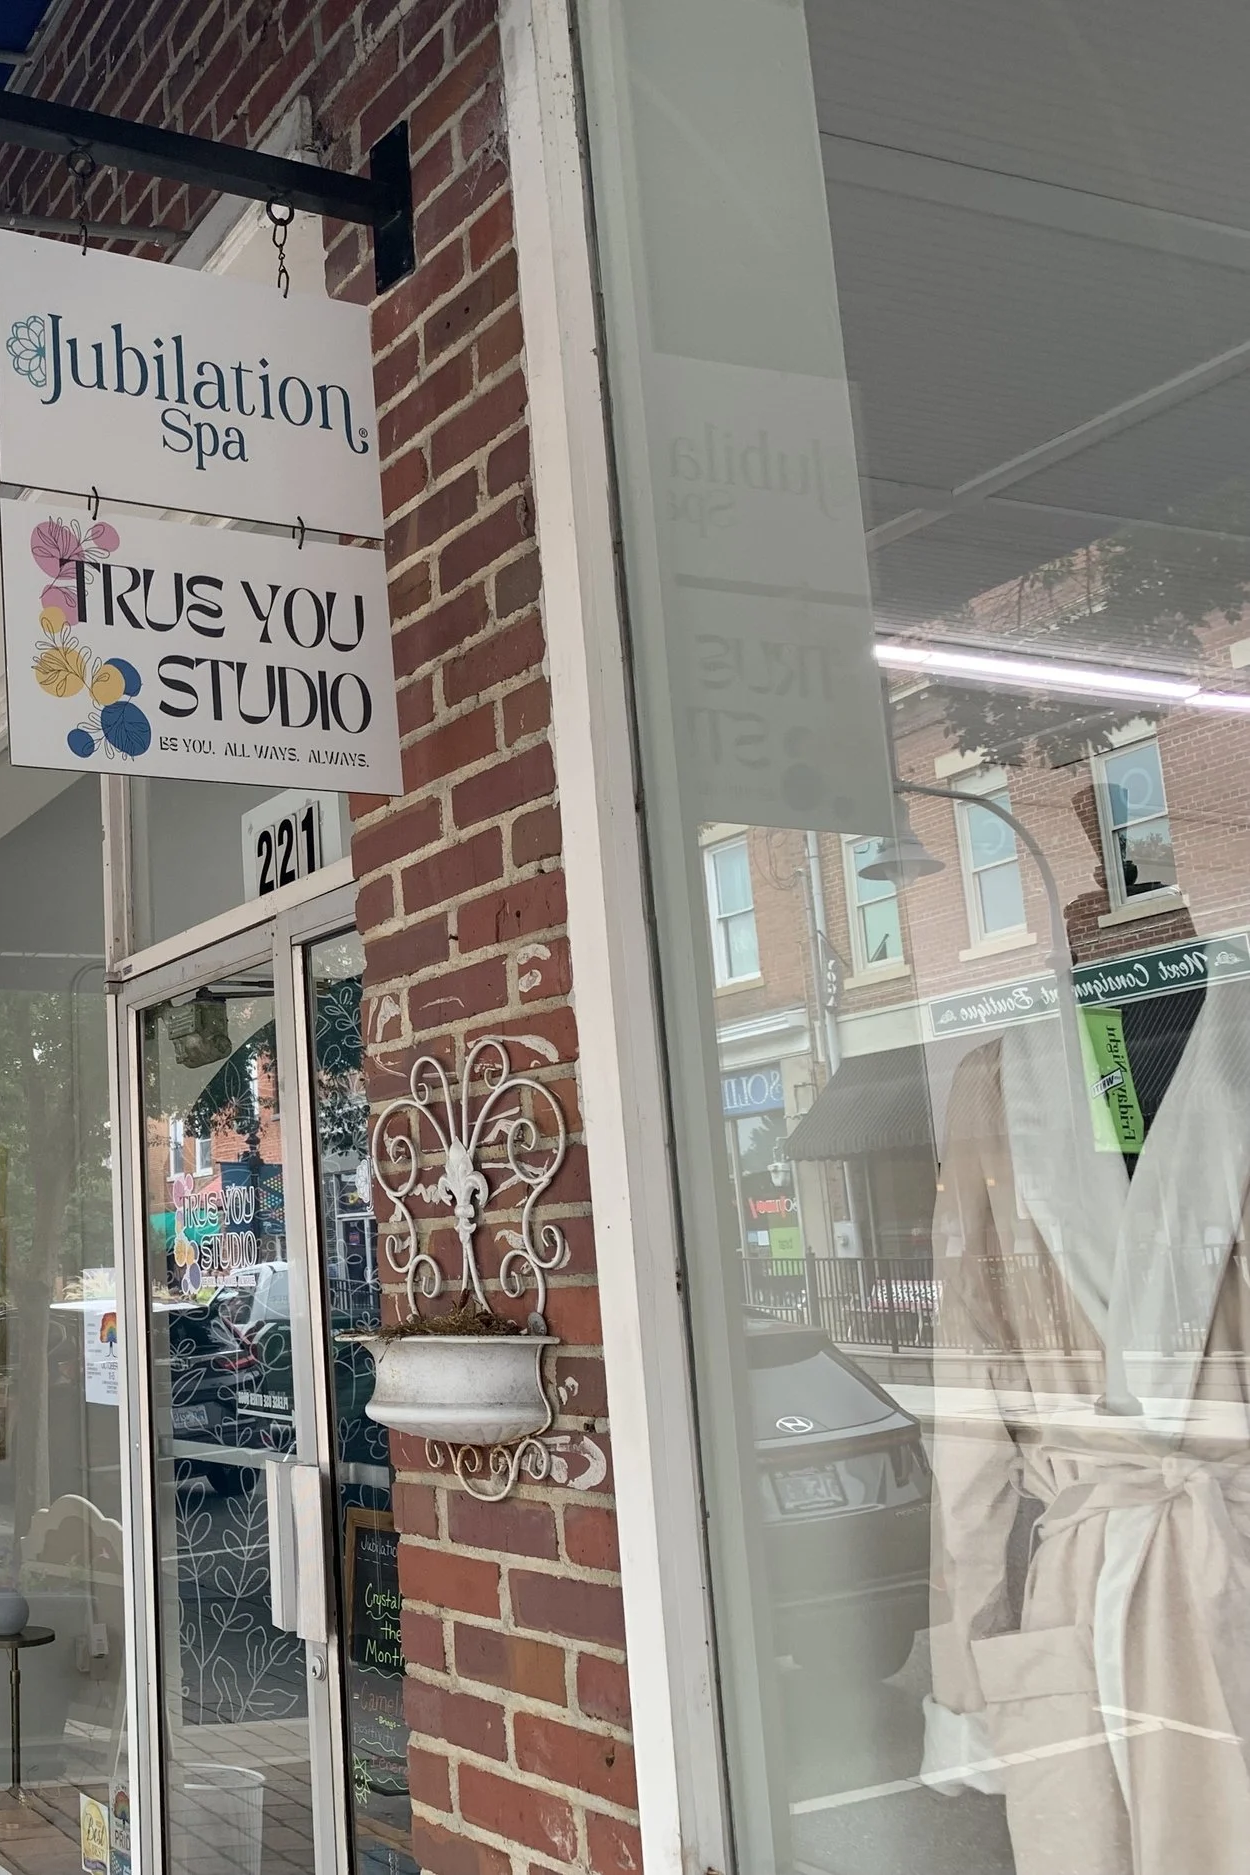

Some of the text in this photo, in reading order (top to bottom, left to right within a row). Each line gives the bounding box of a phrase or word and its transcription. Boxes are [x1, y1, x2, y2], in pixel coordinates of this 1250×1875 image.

[41, 313, 369, 454] Jubilation
[160, 408, 249, 470] Spa
[59, 558, 365, 652] TRUE YOU
[157, 654, 372, 734] STUDIO
[159, 735, 370, 768] BE YOU. ALL WAYS. ALWAYS.
[256, 805, 319, 897] 221
[179, 1191, 218, 1230] TRUE
[221, 1186, 255, 1225] YOU
[200, 1231, 258, 1270] STUDIO
[365, 1583, 401, 1615] Crystal
[380, 1620, 402, 1643] the
[114, 1830, 130, 1850] PRID
